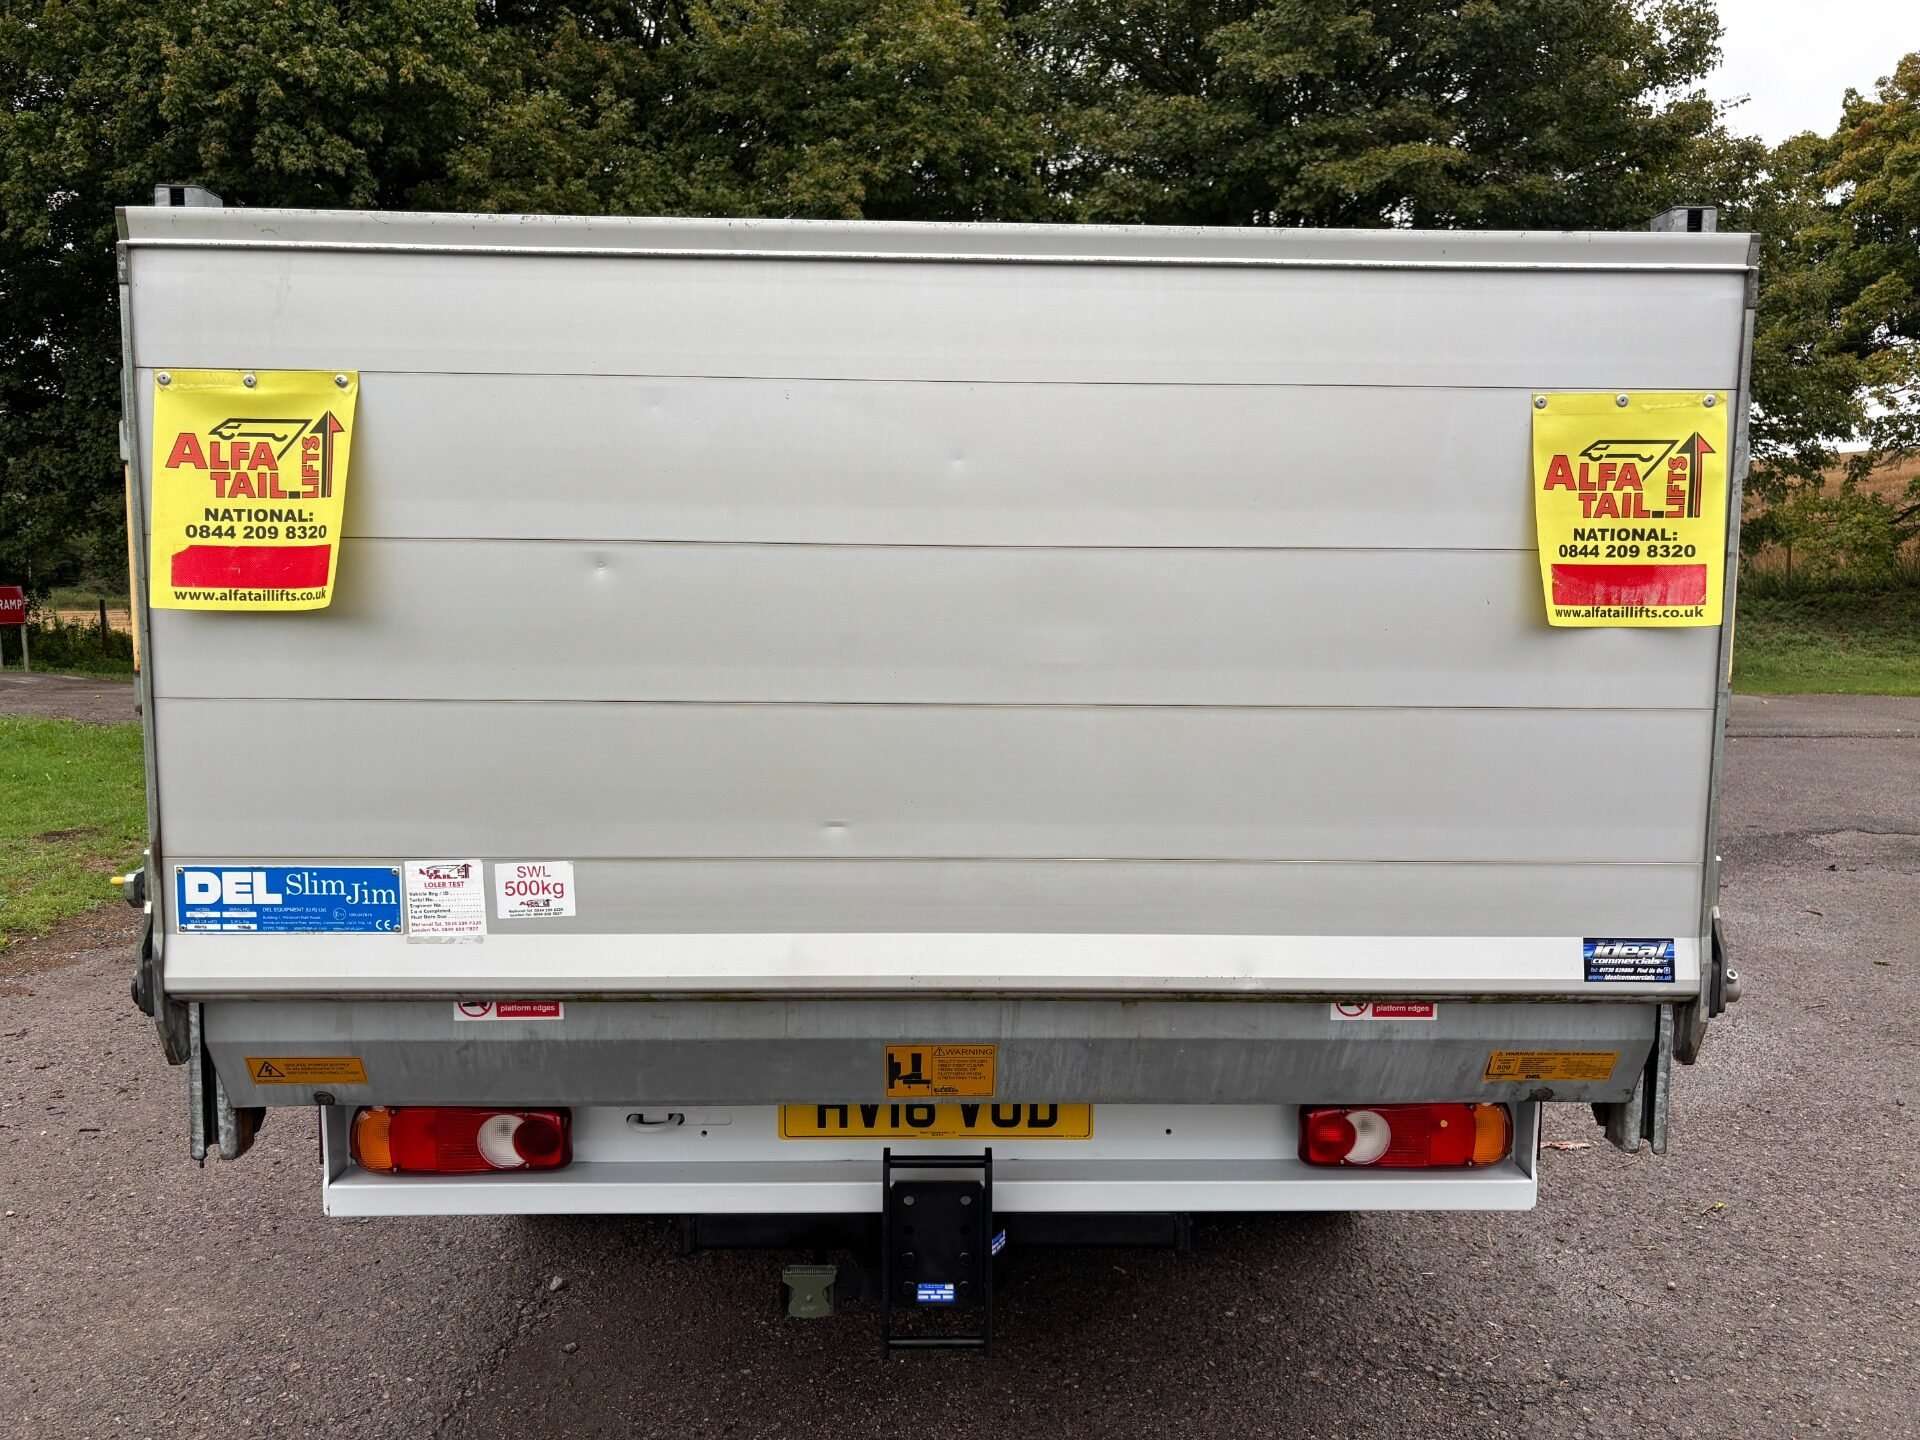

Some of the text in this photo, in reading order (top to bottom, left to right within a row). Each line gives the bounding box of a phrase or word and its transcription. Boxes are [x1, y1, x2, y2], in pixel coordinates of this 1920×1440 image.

[165, 432, 278, 470] ALFA
[301, 435, 321, 499] LIFTS
[1543, 454, 1643, 491] ALFA
[209, 472, 288, 499] TAIL
[1665, 456, 1688, 519] LIFTS
[1578, 492, 1651, 519] TAIL
[204, 508, 314, 523] NATIONAL:
[185, 524, 327, 540] 0844 209 8320
[1572, 527, 1679, 542] NATIONAL:
[1558, 544, 1696, 558] 0844 209 8320
[174, 586, 326, 602] www.alfataillifts.co.uk
[1555, 605, 1704, 619] www.alfataillifts.co.uk
[517, 866, 552, 878] SWL
[185, 871, 397, 905] DEL Slim Jim
[449, 880, 465, 888] TEST
[505, 880, 565, 899] 500kg
[1593, 942, 1668, 958] ideal
[1592, 957, 1661, 965] commercials
[500, 1004, 555, 1013] platform edges
[1376, 1005, 1430, 1013] platform edges
[945, 1048, 993, 1056] WARNING
